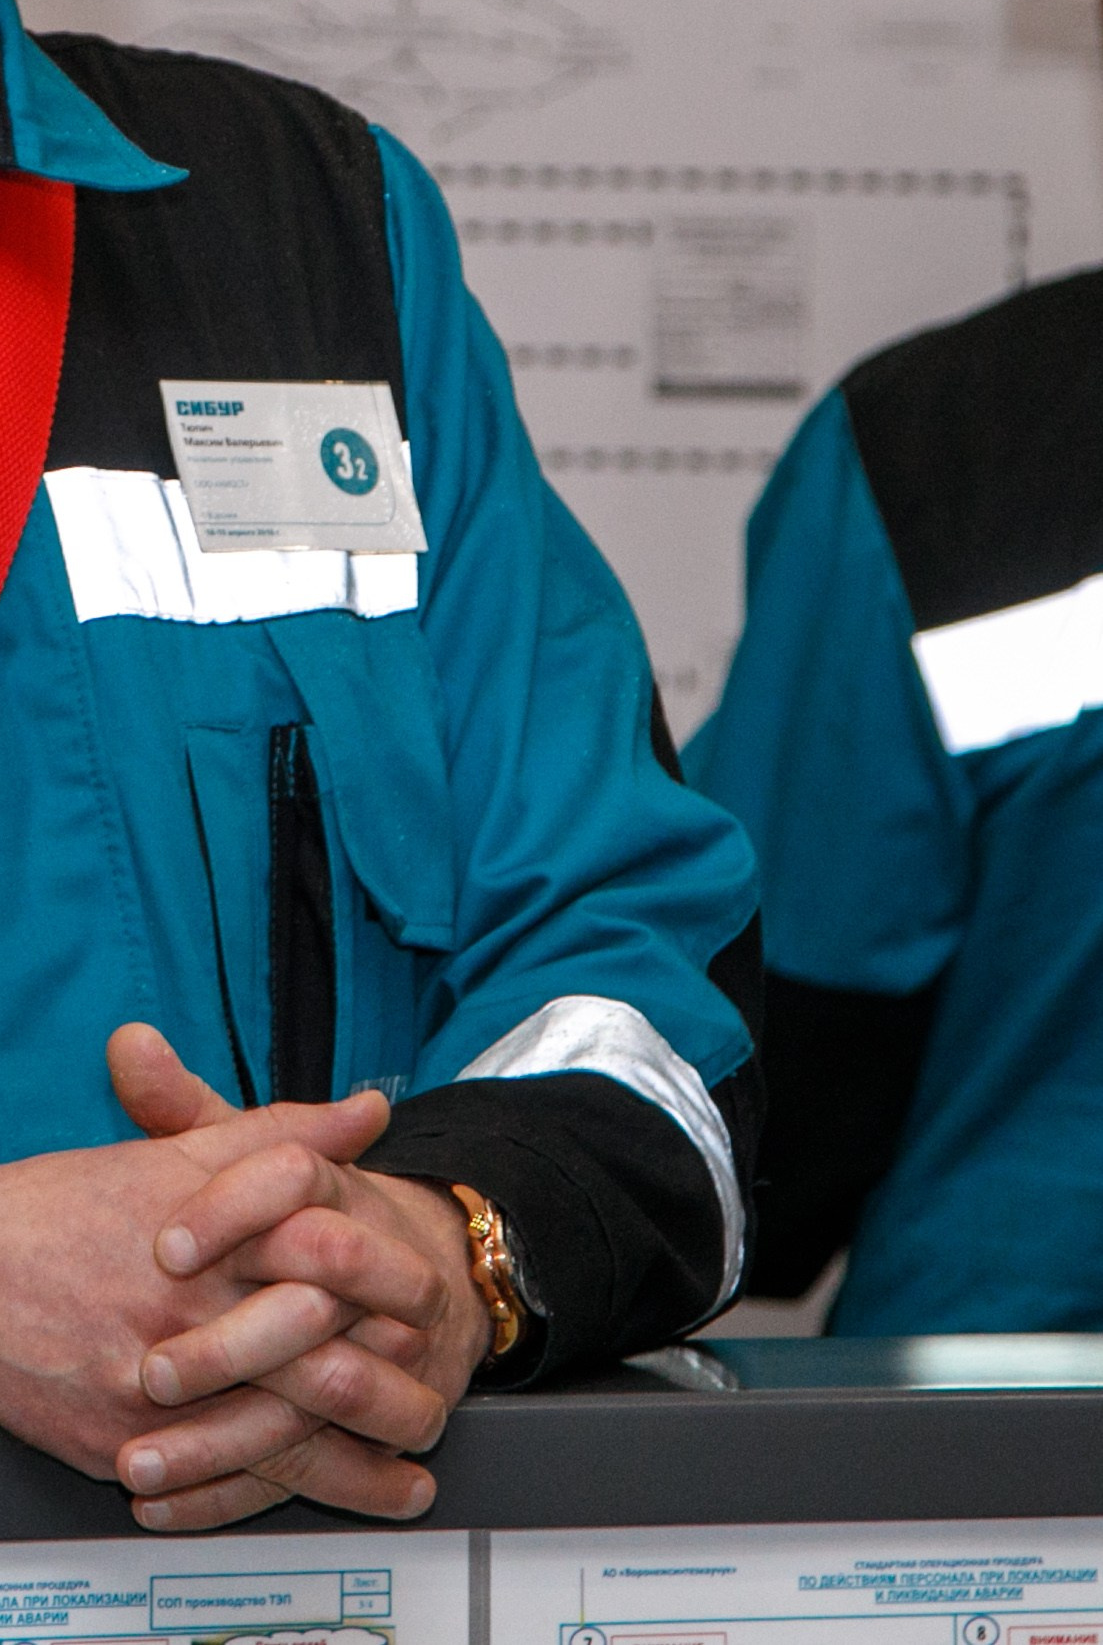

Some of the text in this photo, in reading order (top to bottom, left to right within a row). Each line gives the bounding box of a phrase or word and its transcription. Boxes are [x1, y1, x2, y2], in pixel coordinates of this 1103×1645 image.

[176, 400, 244, 416] СИБУР
[603, 1568, 617, 1578] АО
[799, 1568, 1097, 1588] ПО ДЕЙСТВИЯМ ПЕРСОНАЛА ПРИ ЛОКАЛИЗАЦИИ
[37, 1581, 90, 1591] ПРОЦЕДУРА
[875, 1586, 1023, 1602] И ЛИКВИДАЦИИ АВАРИИ
[23, 1596, 48, 1608] ПРИ
[52, 1592, 147, 1607] ЛОКАЛИЗАЦИИ
[157, 1593, 292, 1610] СОП производство ТЭП
[17, 1612, 68, 1625] АВАРИИ
[976, 1625, 986, 1641] 8
